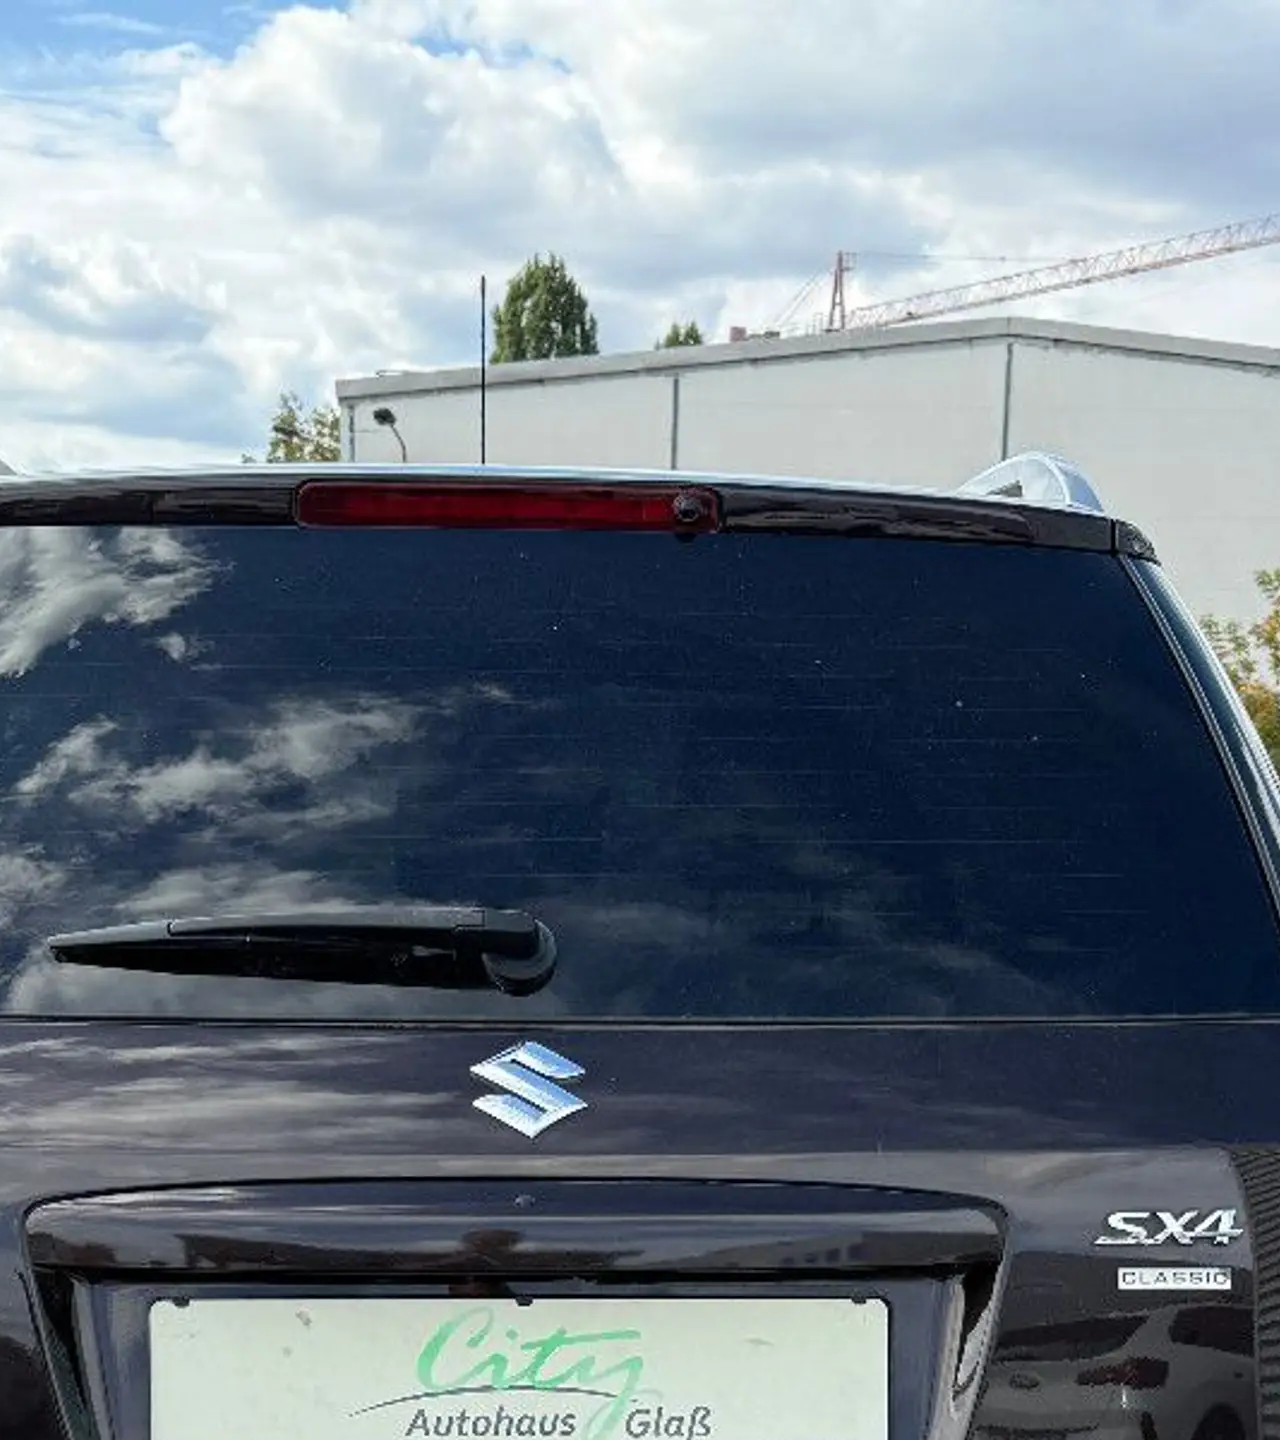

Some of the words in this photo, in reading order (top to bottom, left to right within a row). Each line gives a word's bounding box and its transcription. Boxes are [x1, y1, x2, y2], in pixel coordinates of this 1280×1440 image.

[1094, 1209, 1244, 1245] SX4
[1121, 1270, 1231, 1286] CLASSIC
[405, 1405, 577, 1438] Autohaus
